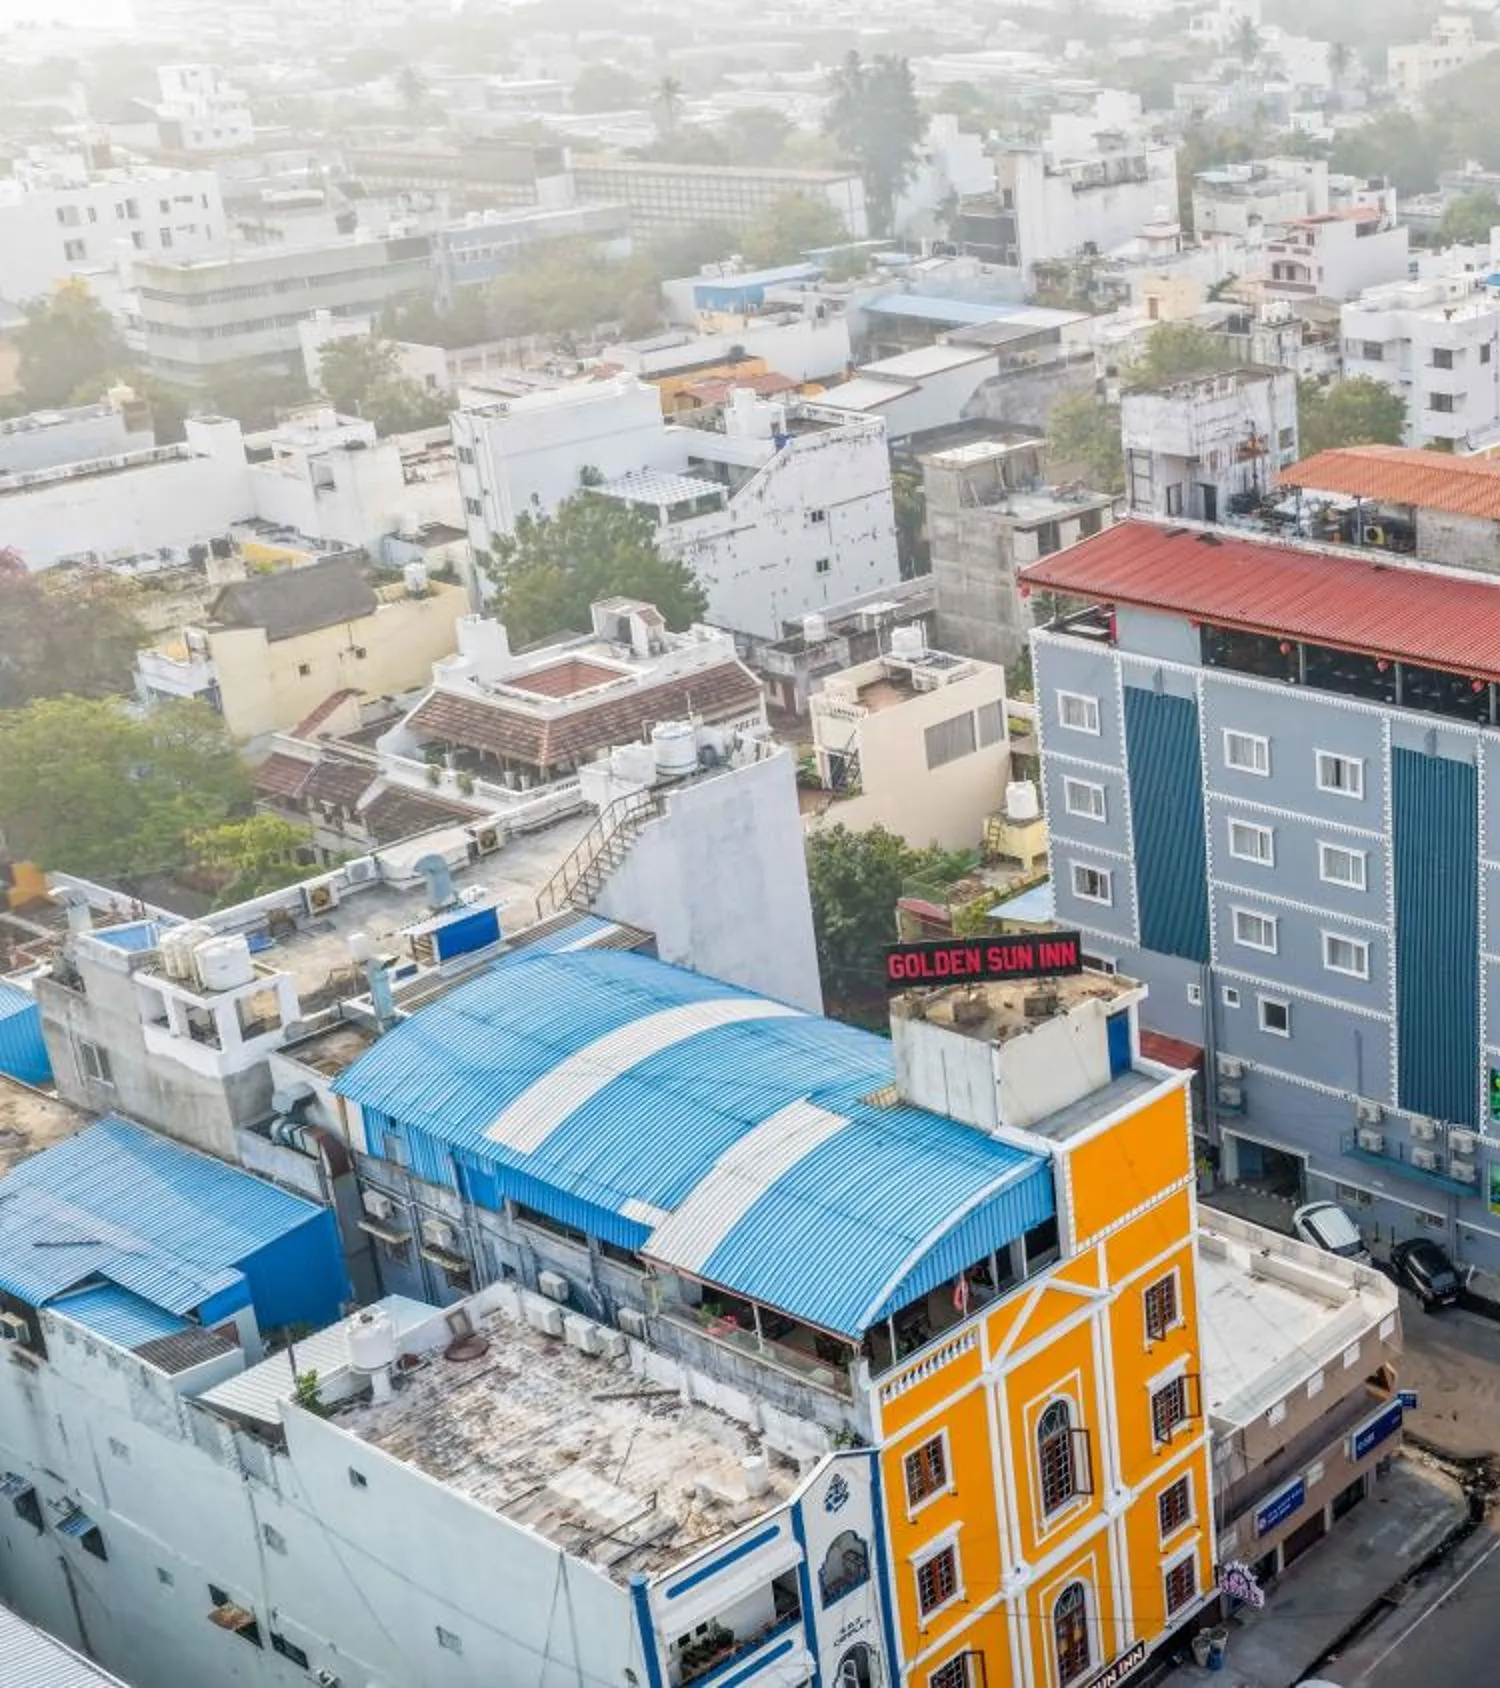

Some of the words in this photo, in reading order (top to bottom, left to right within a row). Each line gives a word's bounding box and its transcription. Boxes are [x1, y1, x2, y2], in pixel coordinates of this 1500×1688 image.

[888, 948, 981, 980] GOLDEN
[987, 944, 1033, 971] SUN
[1040, 942, 1077, 967] INN
[1119, 1646, 1142, 1676] INN
